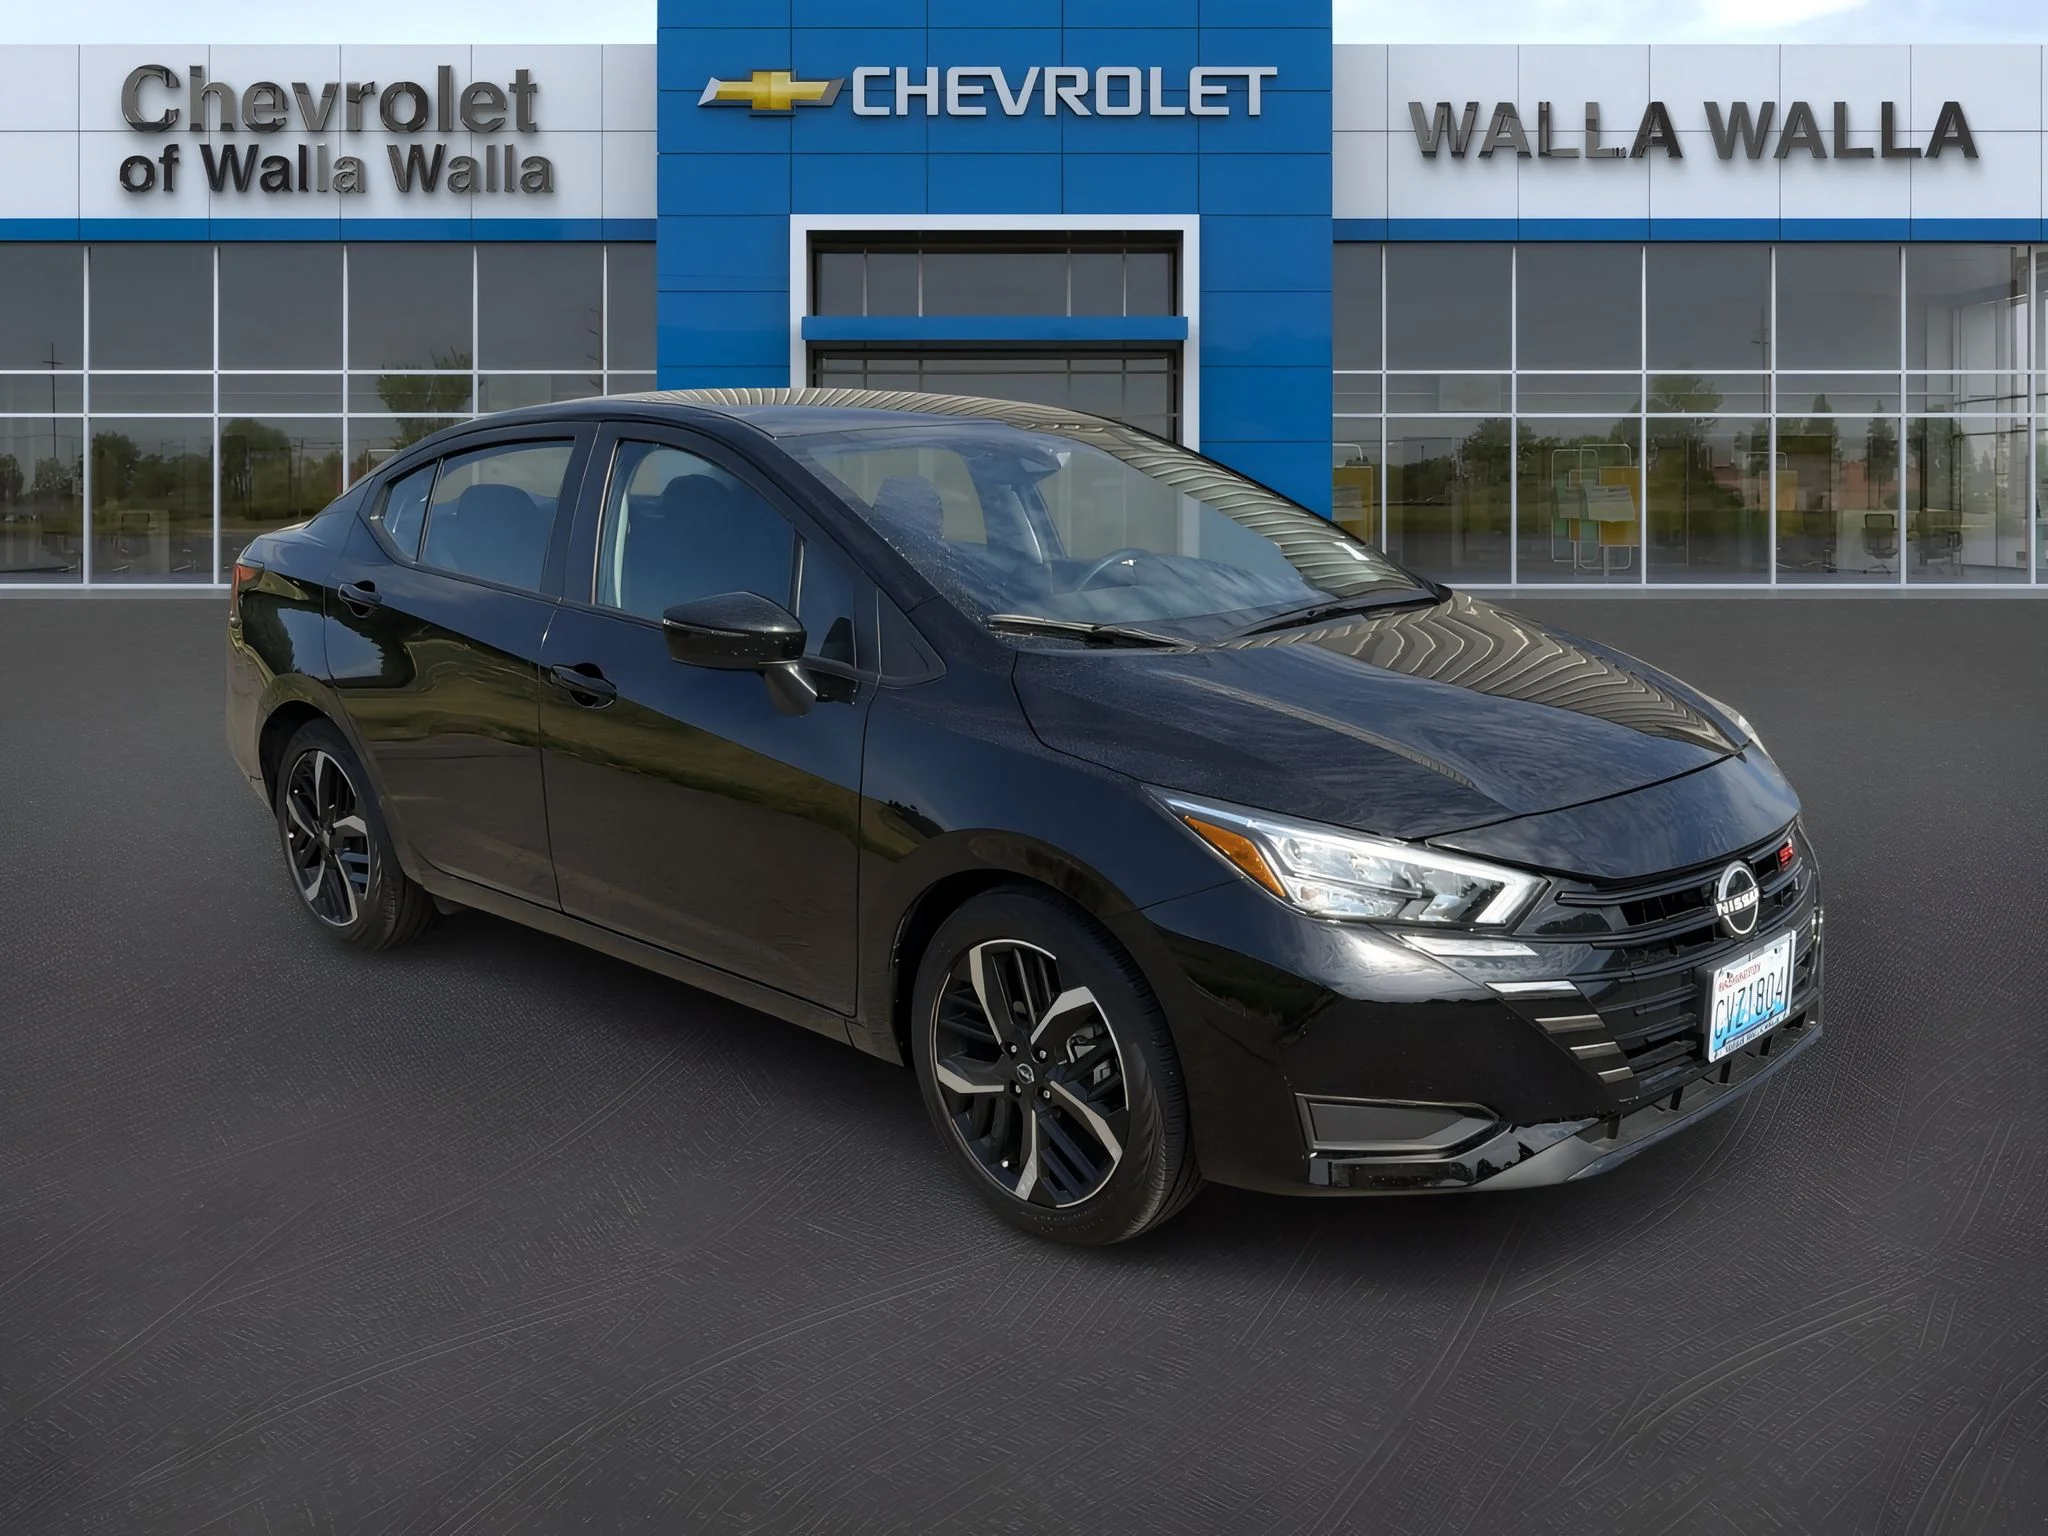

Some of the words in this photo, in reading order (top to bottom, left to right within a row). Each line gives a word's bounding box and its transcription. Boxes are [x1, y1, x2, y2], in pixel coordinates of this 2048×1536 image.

[120, 64, 538, 133] Chevrolet
[852, 66, 1278, 117] CHEVROLET
[1408, 101, 1683, 160] WALLA
[1703, 101, 1979, 160] WALLA
[119, 143, 180, 193] of
[199, 143, 367, 193] Walla
[386, 143, 555, 193] Walla
